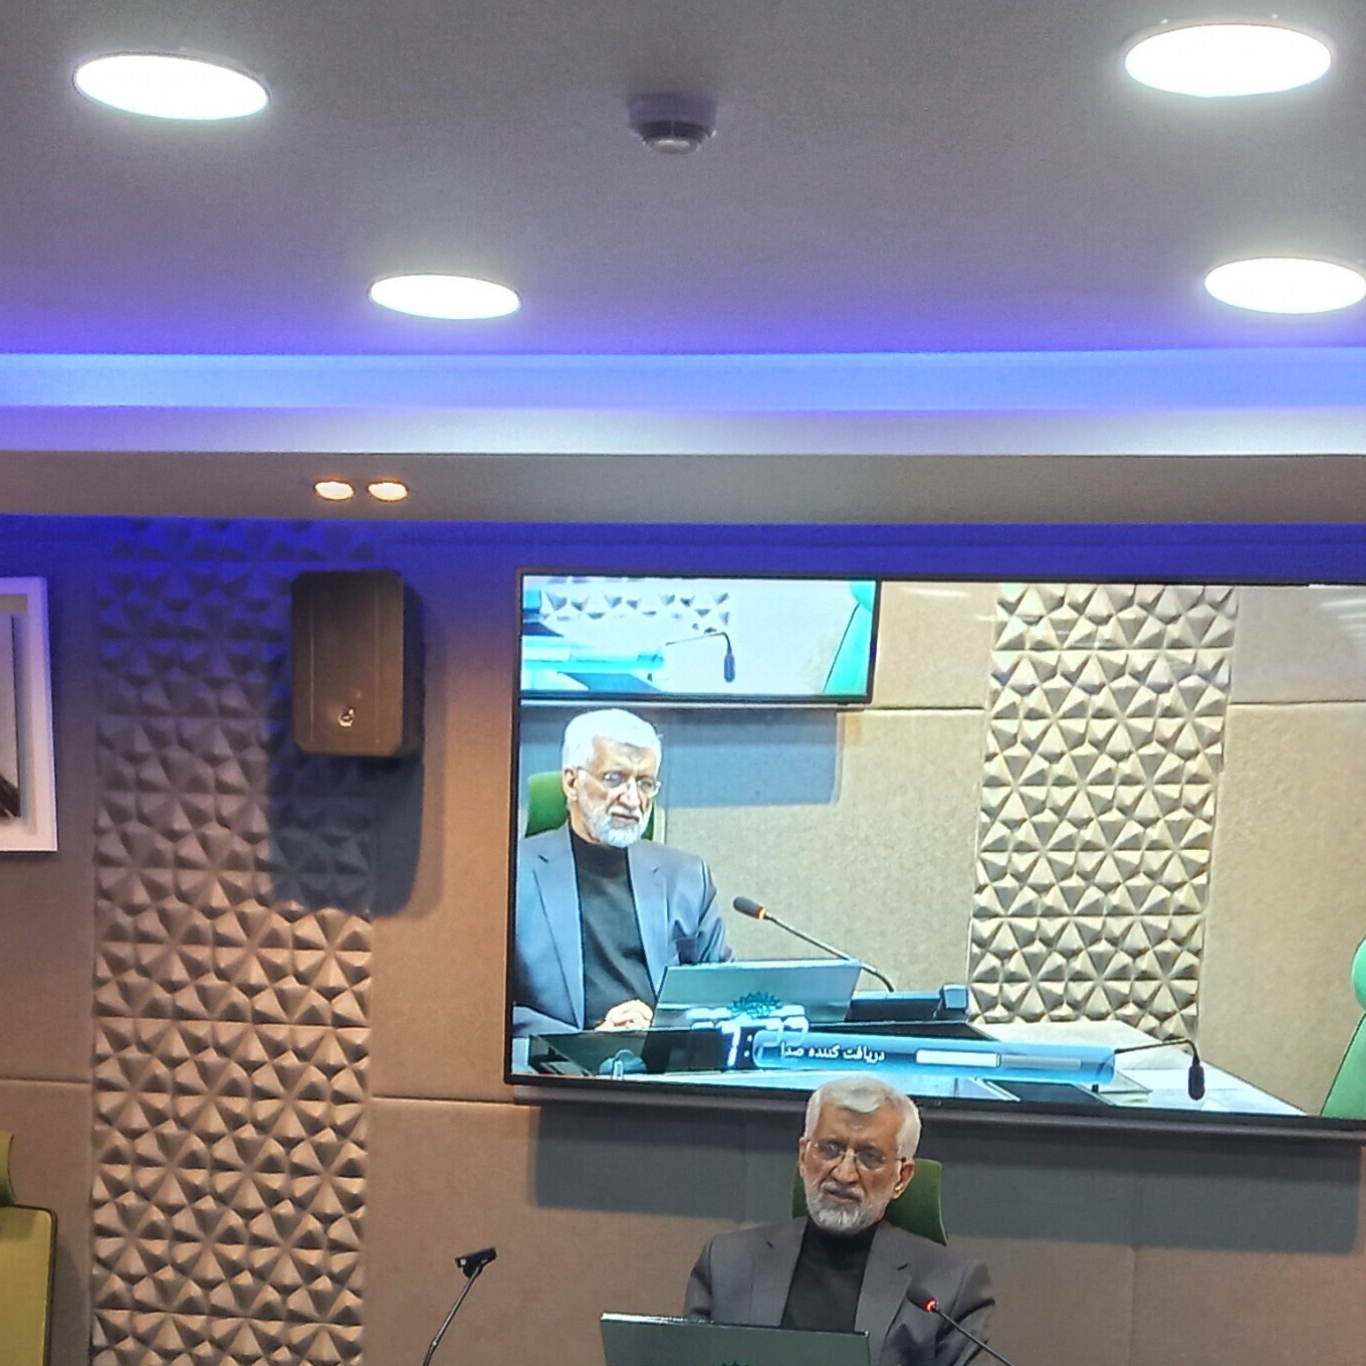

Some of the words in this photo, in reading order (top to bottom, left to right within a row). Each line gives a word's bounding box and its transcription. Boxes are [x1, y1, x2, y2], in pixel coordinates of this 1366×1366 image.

[781, 1042, 804, 1057] صدا
[808, 1044, 840, 1058] کننده
[843, 1044, 885, 1064] دریافت
